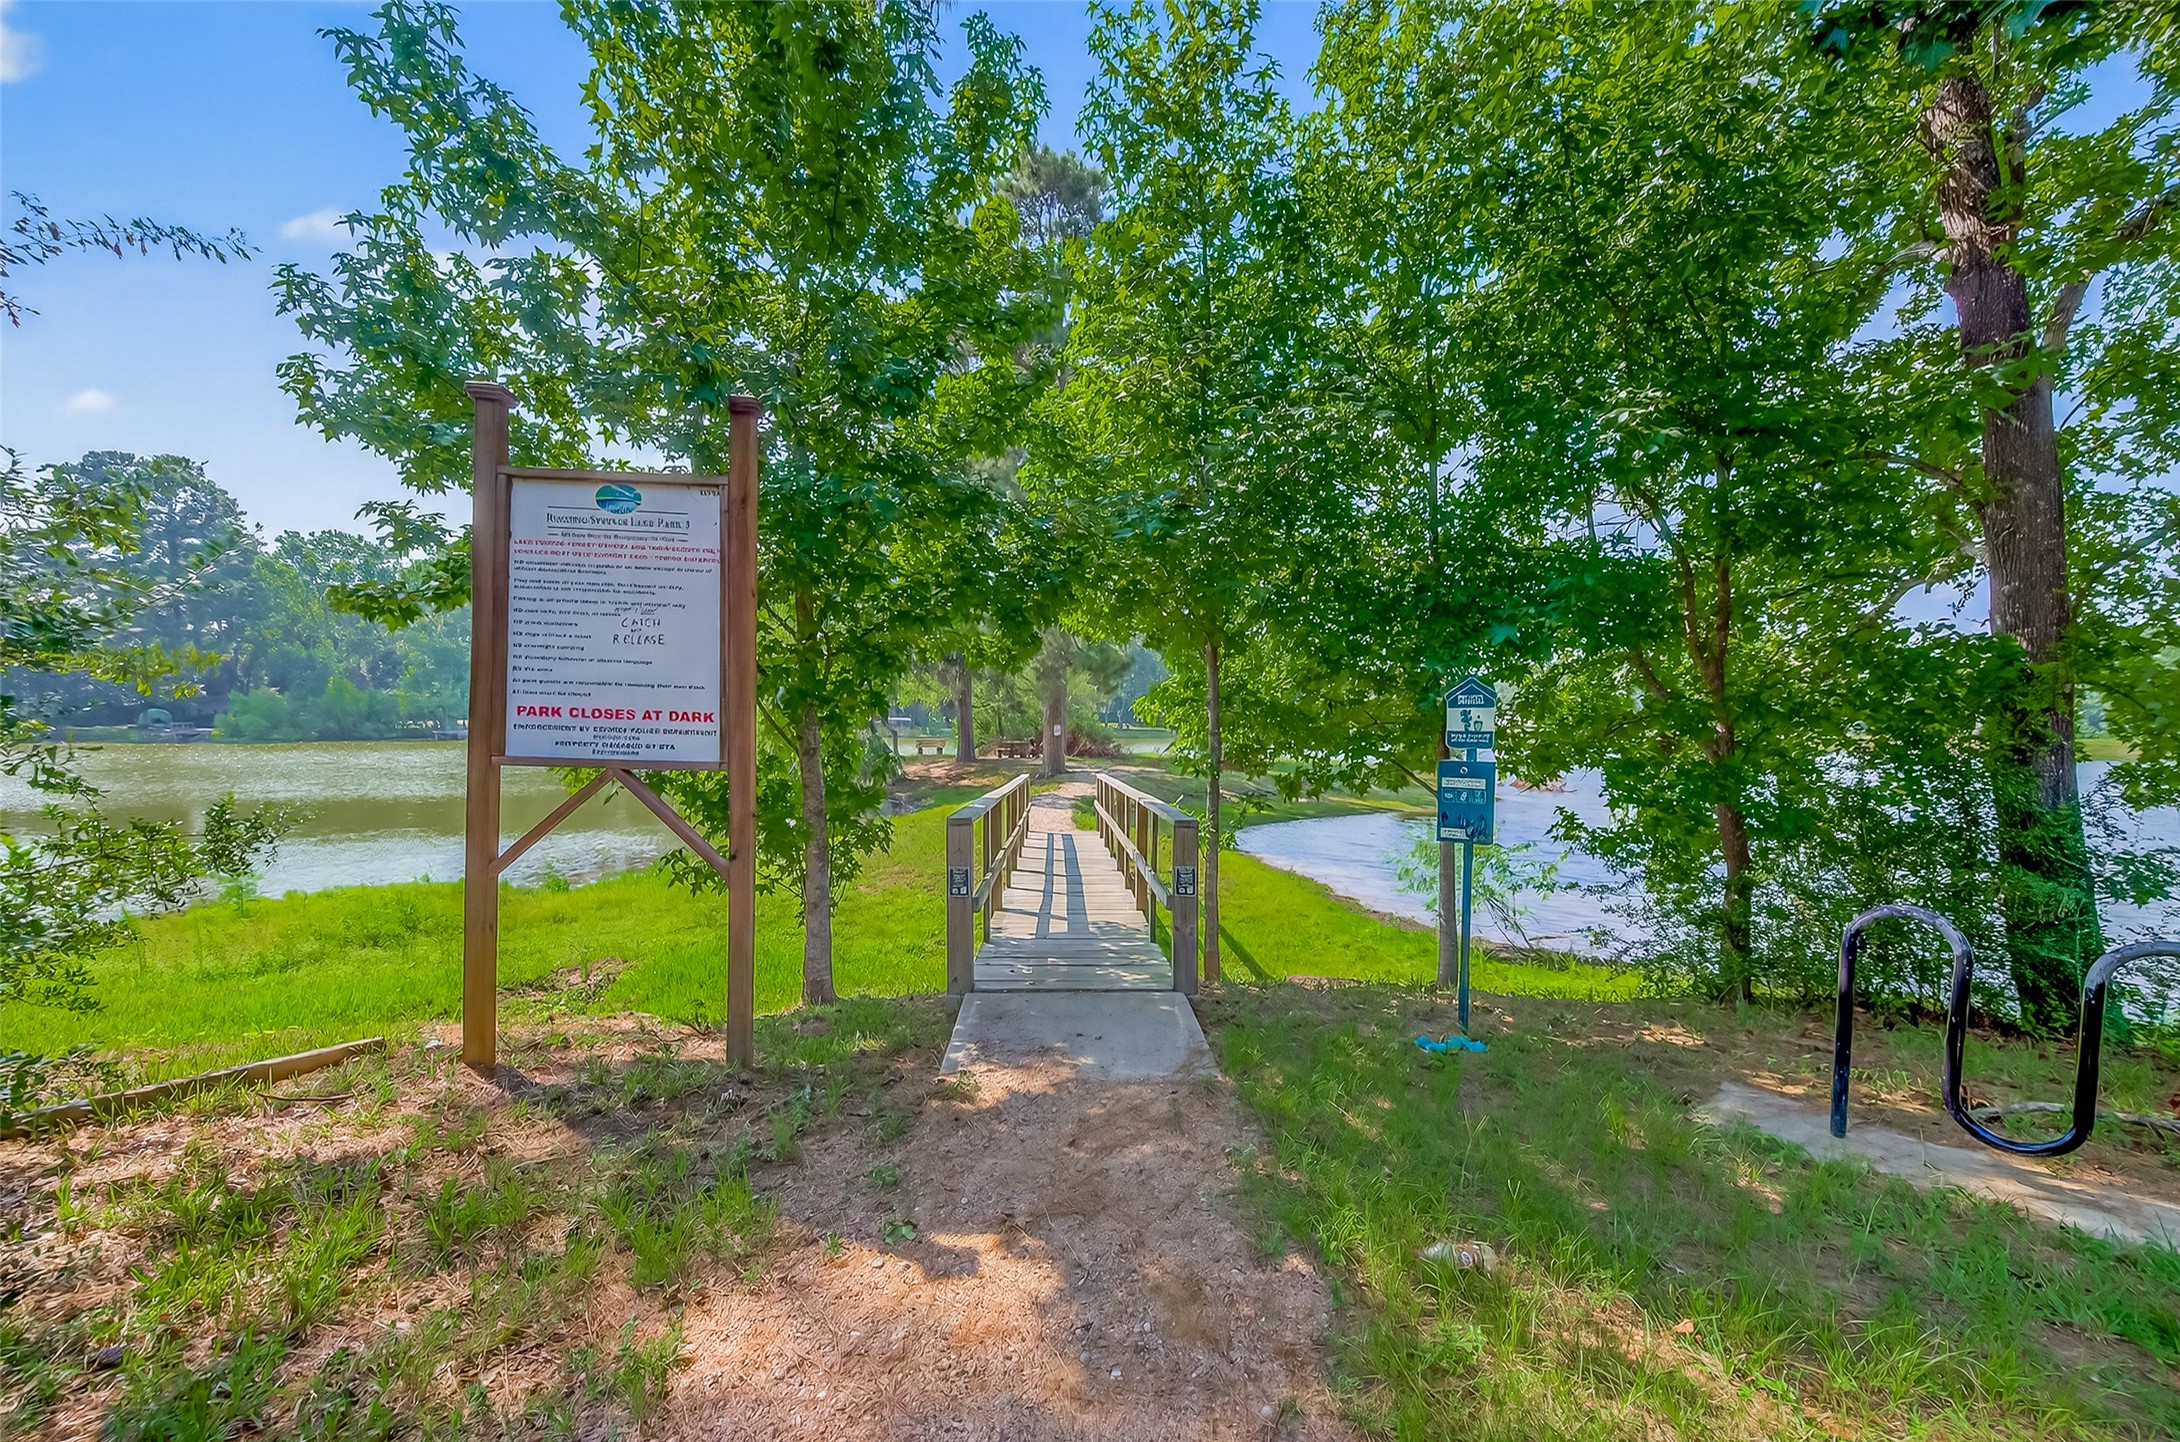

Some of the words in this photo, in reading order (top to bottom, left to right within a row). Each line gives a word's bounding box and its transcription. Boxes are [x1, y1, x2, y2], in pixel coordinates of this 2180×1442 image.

[621, 617, 661, 628] CATCH
[612, 634, 665, 645] RELEASE
[517, 705, 562, 718] PARK
[569, 707, 636, 720] CLOSES
[642, 709, 663, 720] AT
[669, 710, 715, 723] DARK
